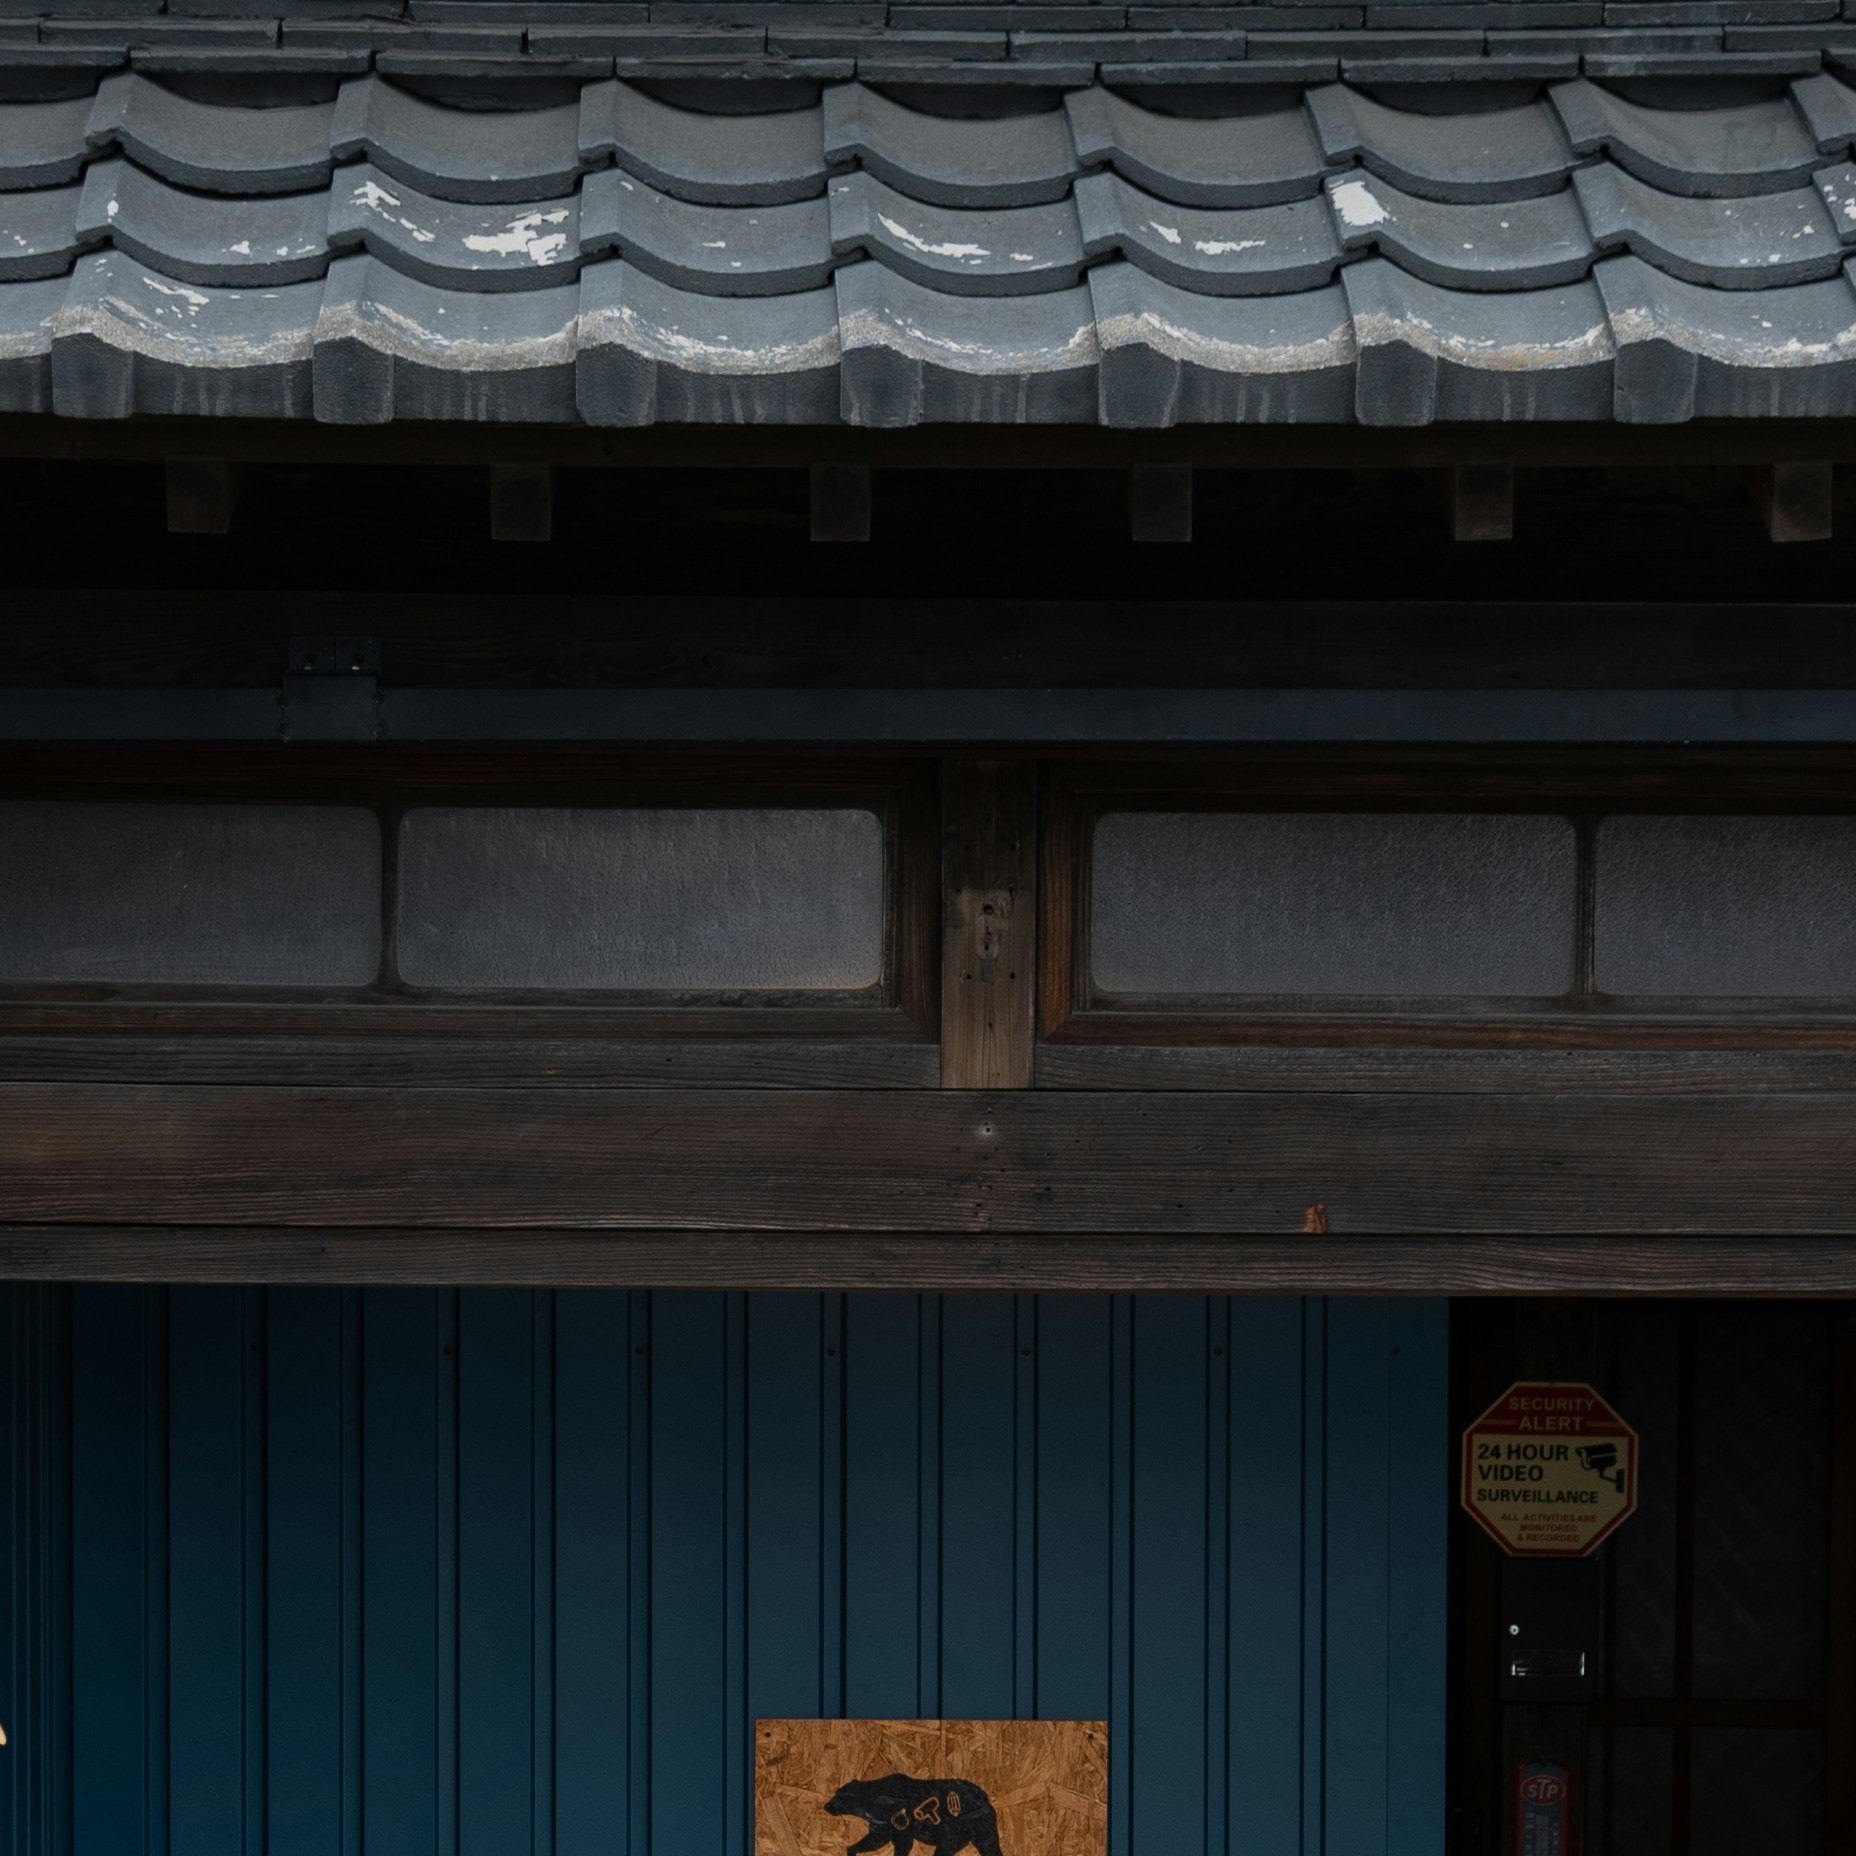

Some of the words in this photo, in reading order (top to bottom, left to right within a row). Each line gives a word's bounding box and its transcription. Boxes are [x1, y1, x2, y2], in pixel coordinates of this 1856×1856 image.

[1508, 1397, 1595, 1411] SECURITY
[1518, 1415, 1584, 1431] ALERT
[1477, 1444, 1502, 1460] 24
[1507, 1444, 1568, 1461] HOUR
[1478, 1464, 1544, 1482] VIDEO
[1477, 1488, 1598, 1504] SURVEILLANCE
[1501, 1513, 1519, 1522] ALL
[1523, 1513, 1576, 1523] ACTIVITIES
[1577, 1514, 1597, 1523] ARE
[1520, 1523, 1578, 1533] MONITORED
[1517, 1534, 1524, 1542] &
[1525, 1533, 1580, 1543] RECORDED
[1527, 1779, 1559, 1800] STP
